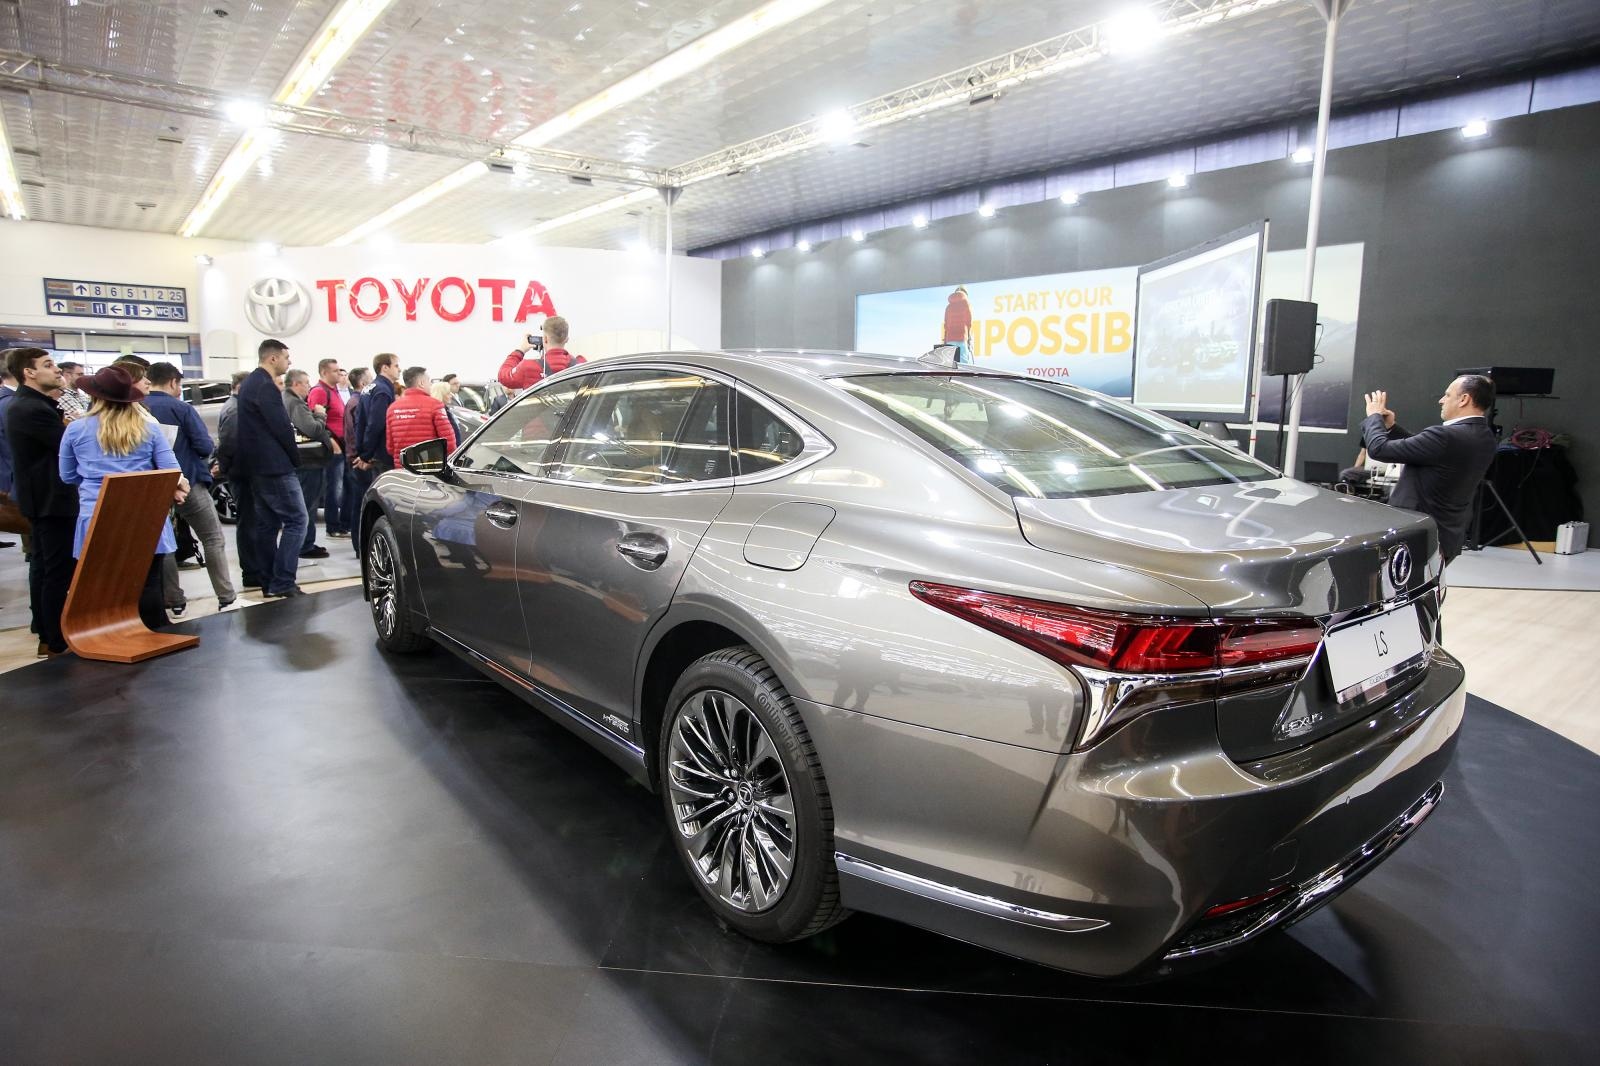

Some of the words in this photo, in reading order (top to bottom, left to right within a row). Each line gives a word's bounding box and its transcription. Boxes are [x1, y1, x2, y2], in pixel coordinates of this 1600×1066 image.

[95, 286, 101, 296] 8
[111, 287, 117, 297] 6
[127, 288, 133, 298] 5
[143, 290, 148, 299] 1
[157, 291, 163, 300] 2
[170, 291, 182, 301] 25
[316, 277, 558, 323] TOYOTA
[994, 290, 1048, 313] START
[1055, 286, 1113, 309] YOUR
[156, 307, 168, 317] WC
[941, 311, 1132, 357] POSSIB
[1026, 367, 1070, 377] TOYOTA
[1374, 630, 1389, 657] LS
[757, 692, 798, 752] Continental
